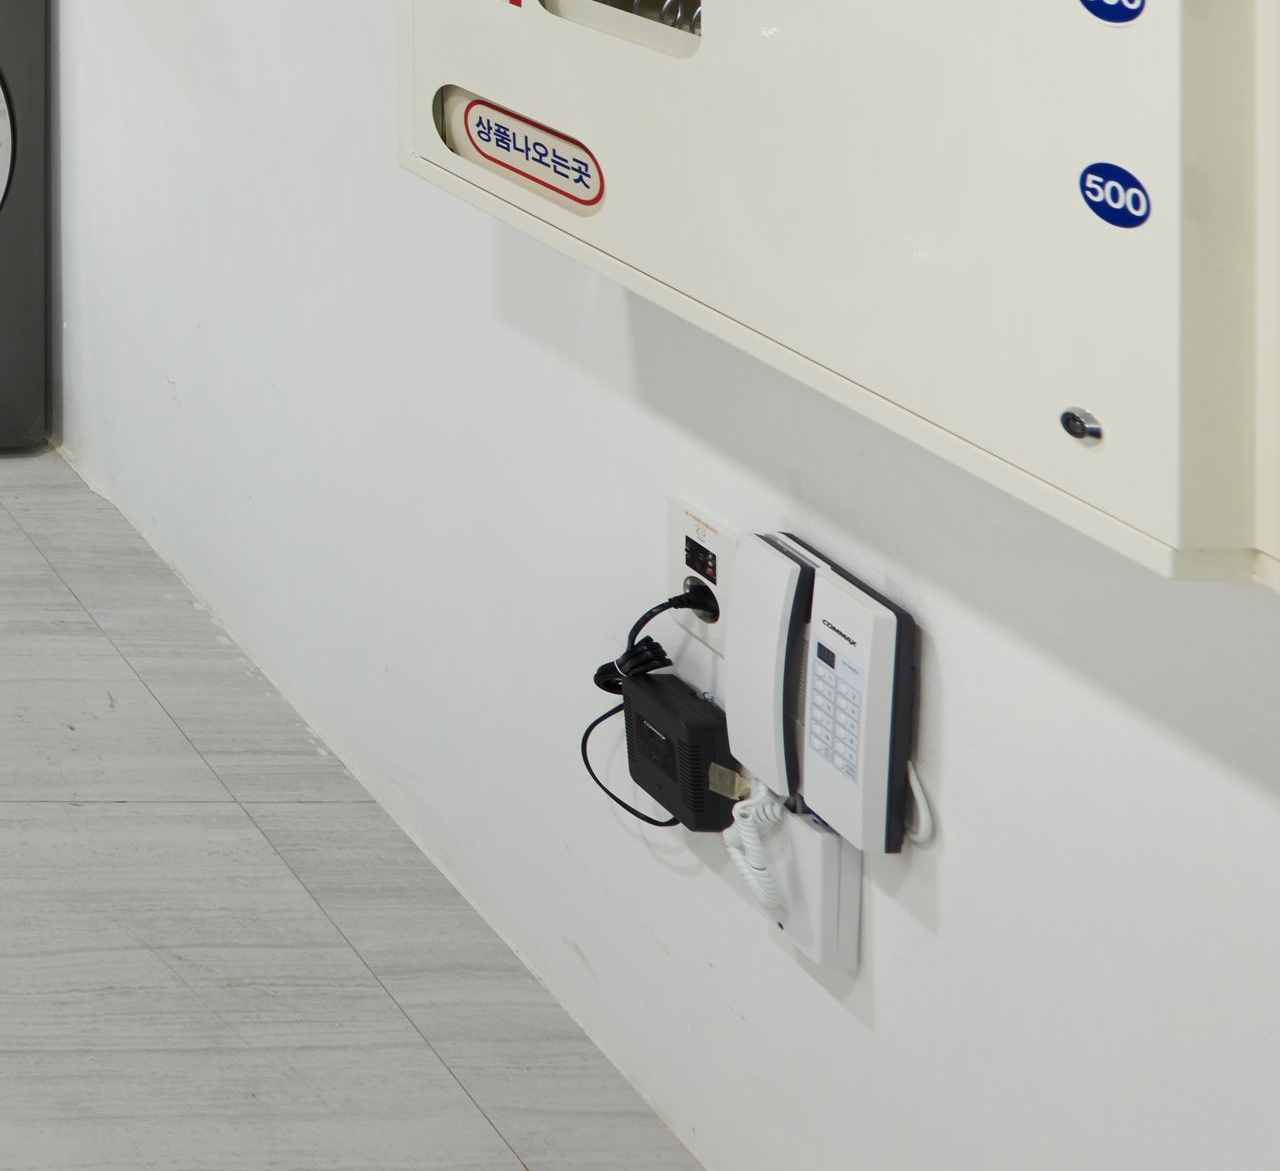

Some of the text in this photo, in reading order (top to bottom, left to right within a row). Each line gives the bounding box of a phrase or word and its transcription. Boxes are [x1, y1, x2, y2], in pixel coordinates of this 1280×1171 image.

[475, 116, 592, 189] 상품나오는곳
[1085, 173, 1147, 217] 500
[822, 618, 857, 648] COMMAX
